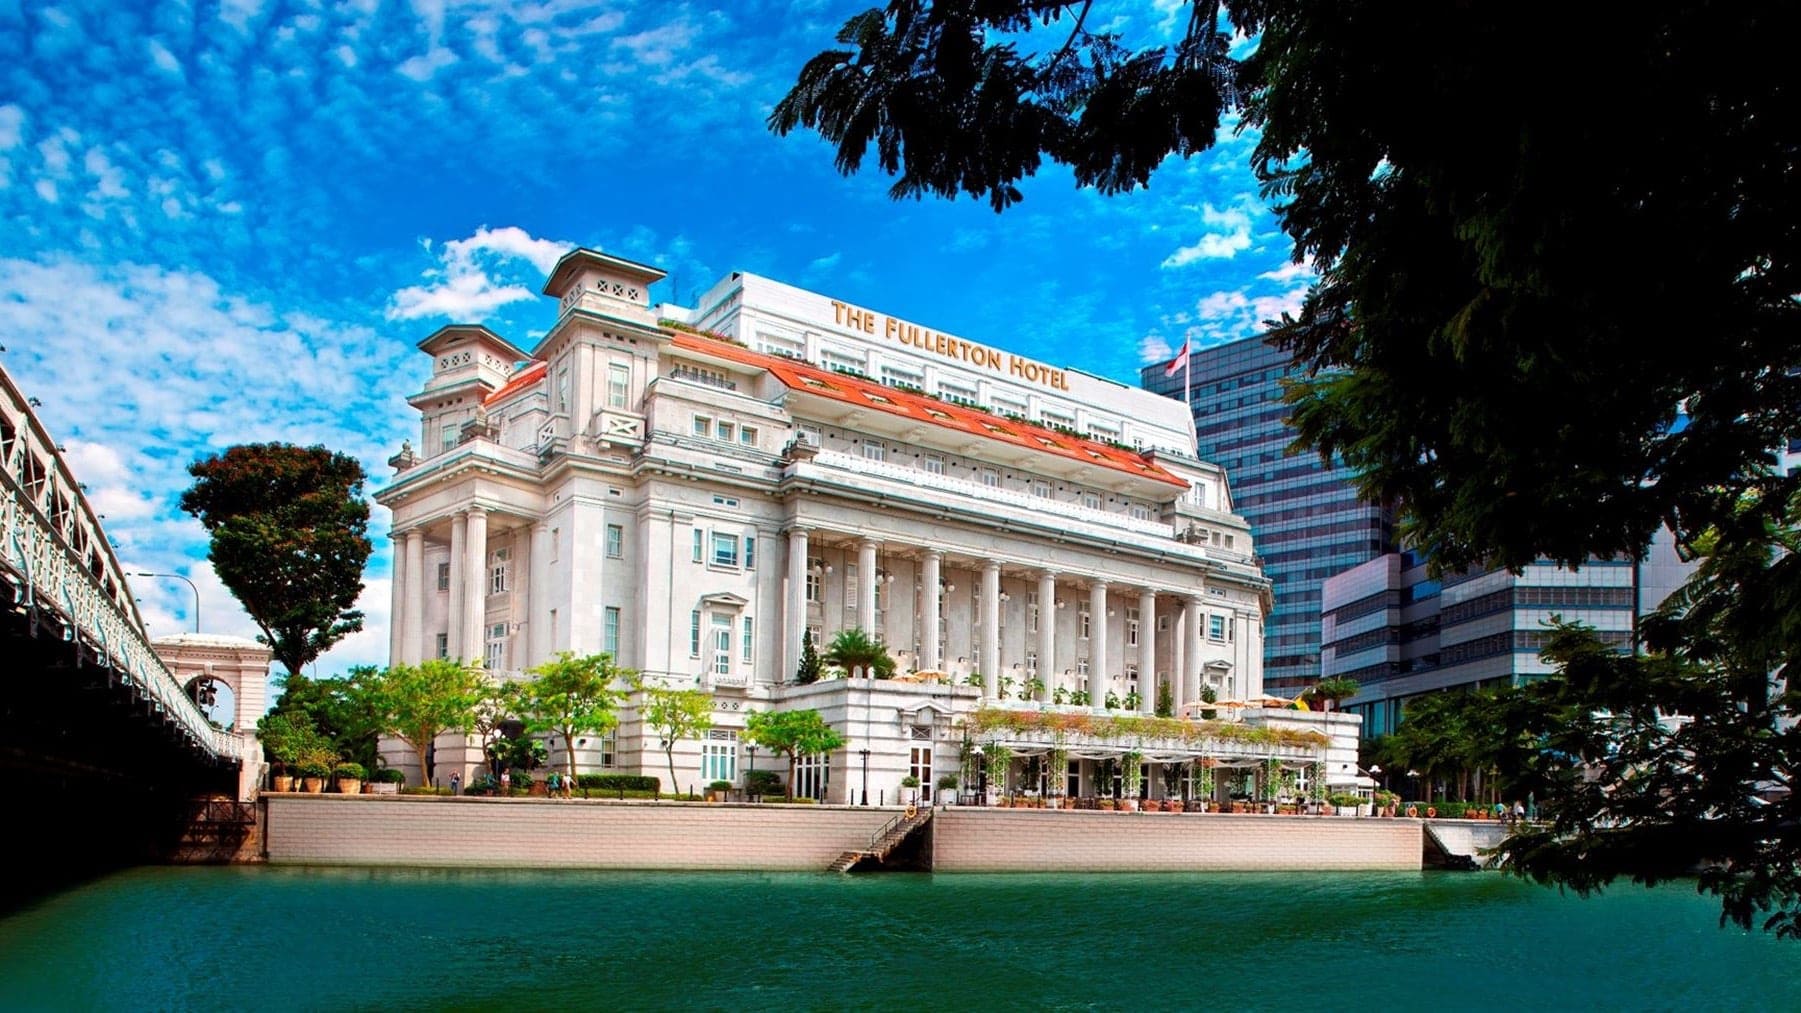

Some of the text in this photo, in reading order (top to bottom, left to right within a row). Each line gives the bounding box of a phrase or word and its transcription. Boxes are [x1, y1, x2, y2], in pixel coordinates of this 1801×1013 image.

[832, 300, 1069, 391] THE FULLERTON HOTEL
